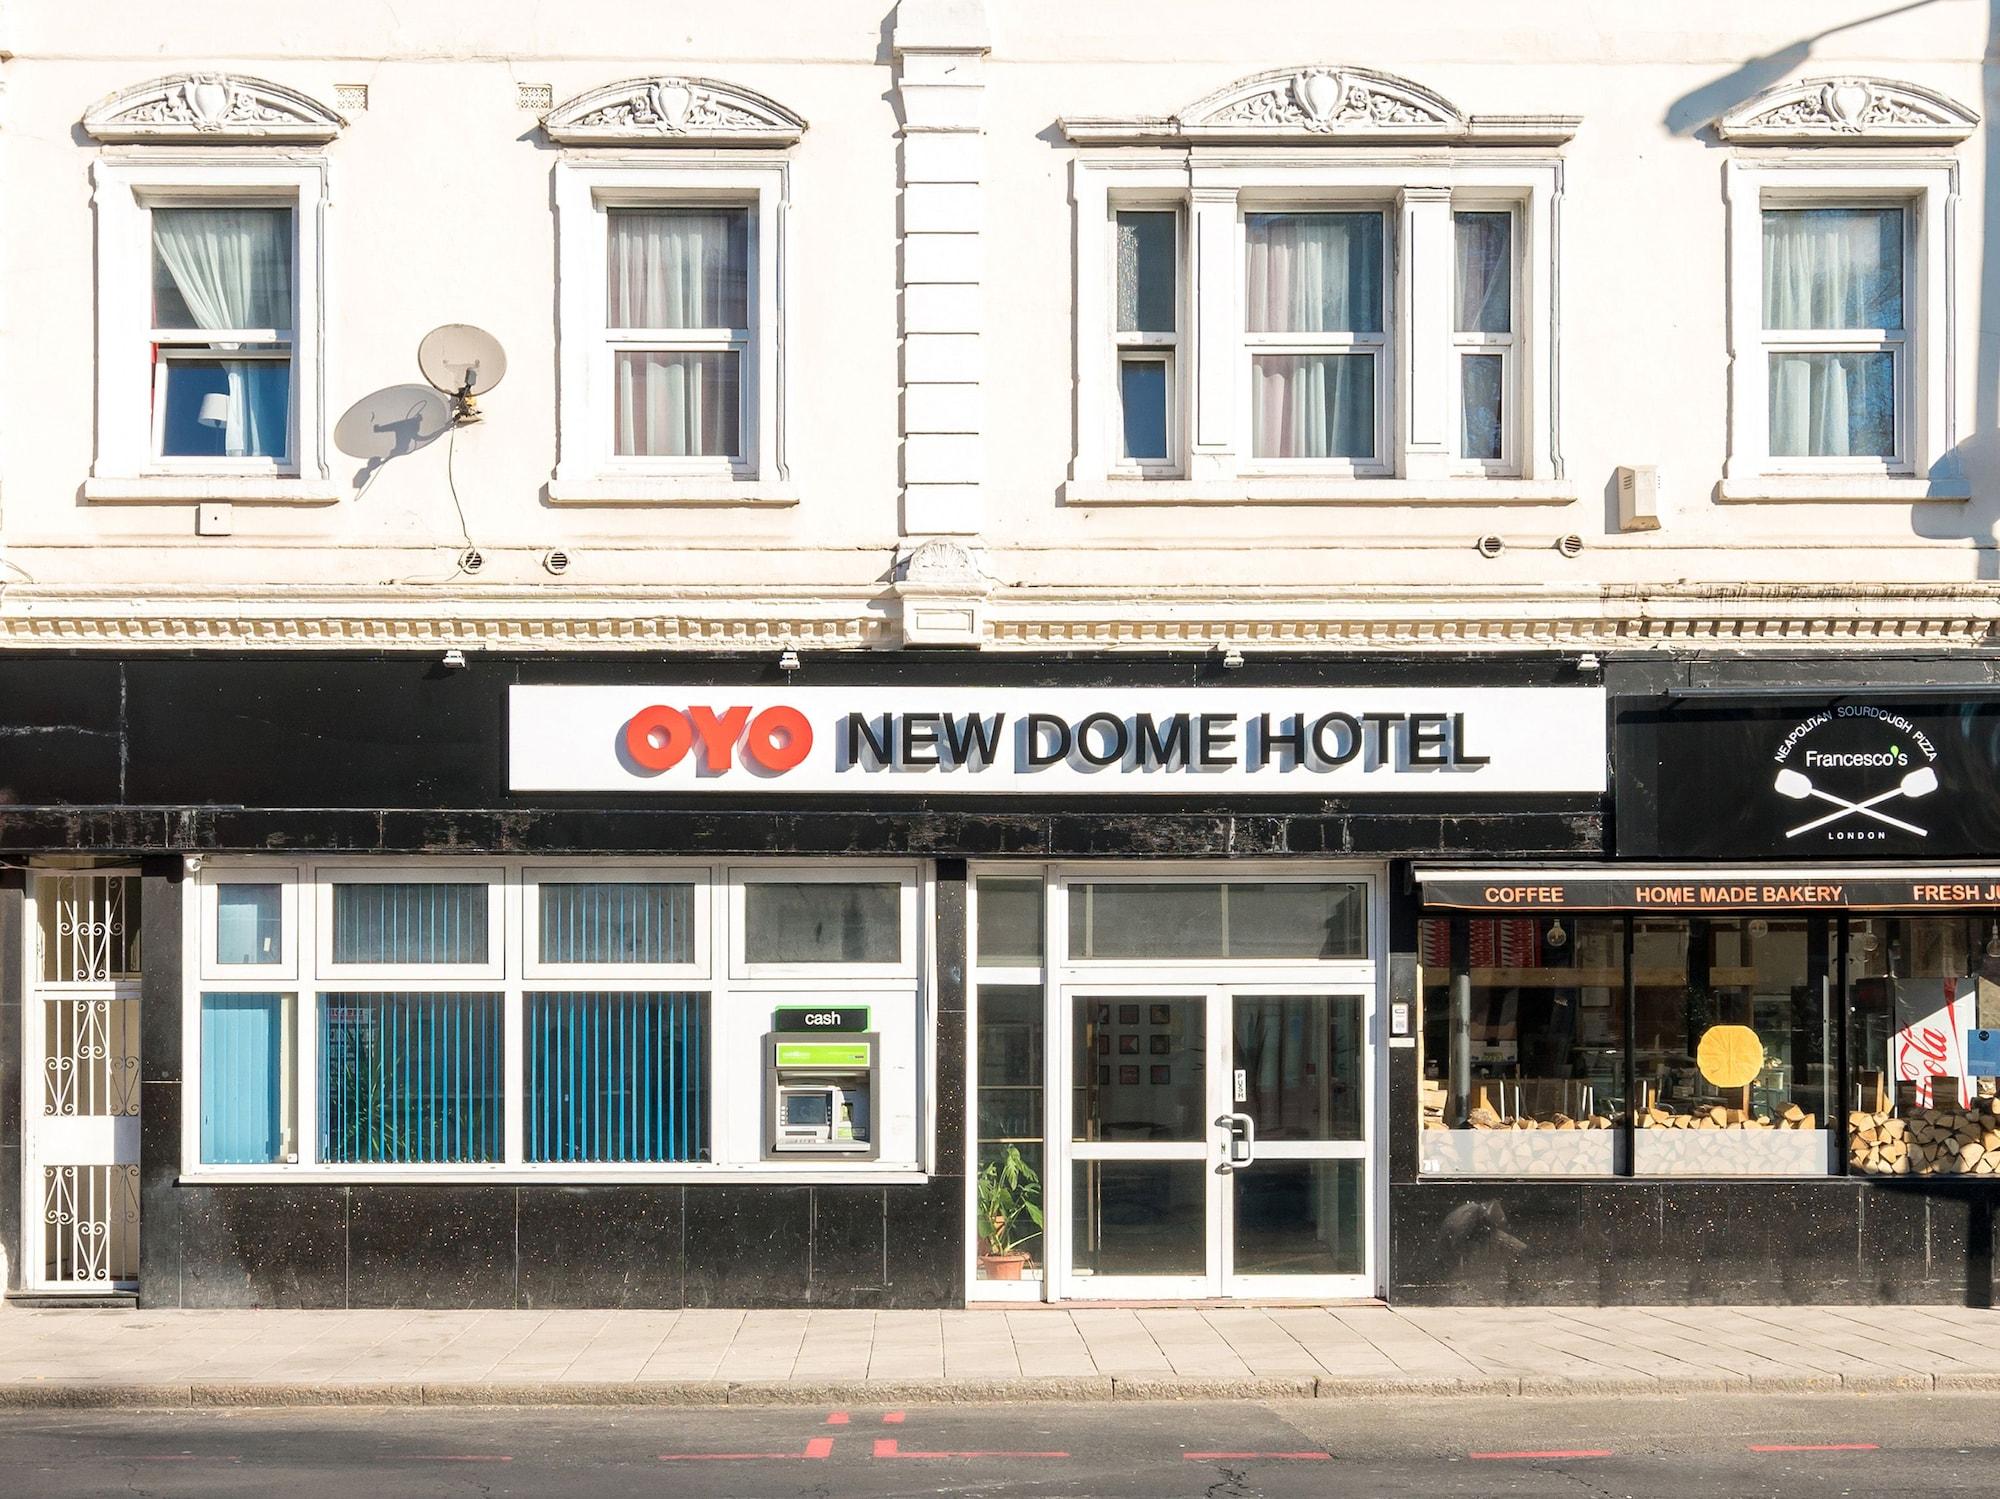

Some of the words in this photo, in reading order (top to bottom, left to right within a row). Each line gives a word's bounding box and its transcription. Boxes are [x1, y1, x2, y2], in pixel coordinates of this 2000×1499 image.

[627, 705, 814, 773] OYO
[848, 713, 1004, 765] NEW
[1027, 714, 1238, 766] DOME
[1261, 713, 1490, 765] HOTEL
[1774, 710, 1833, 763] NEAPOLITAN
[1837, 705, 1913, 734] SOURDOUGH
[1912, 730, 1938, 762] PIZZA
[1806, 745, 1908, 767] Francesco's
[1828, 831, 1886, 840] LONDON
[1485, 887, 1565, 904] COFFEE
[1636, 887, 1696, 904] HOME
[1700, 887, 1759, 904] MADE
[1762, 886, 1843, 903] BAKERY
[1913, 885, 1980, 901] FRESH
[804, 1010, 841, 1025] cash
